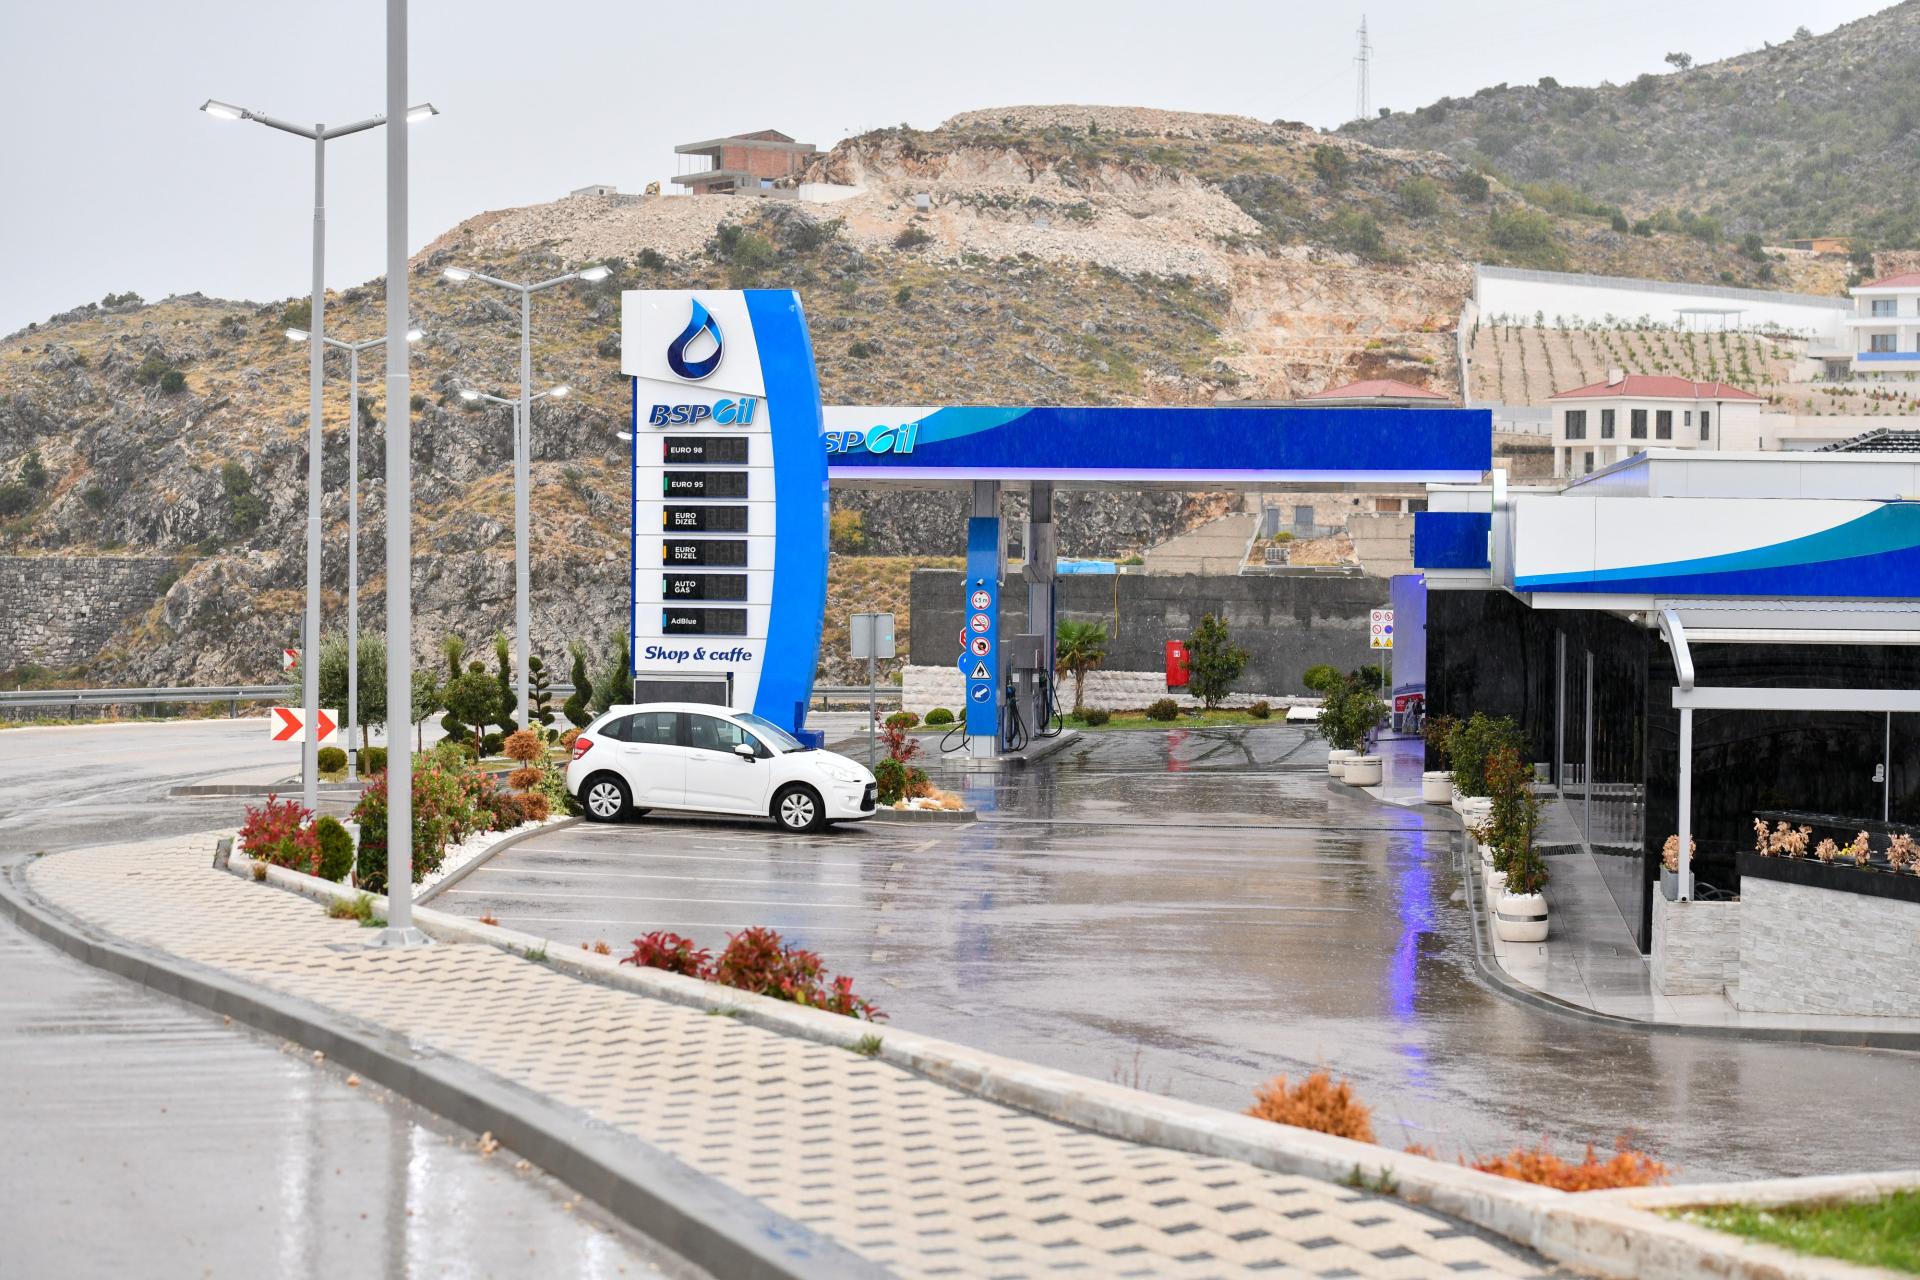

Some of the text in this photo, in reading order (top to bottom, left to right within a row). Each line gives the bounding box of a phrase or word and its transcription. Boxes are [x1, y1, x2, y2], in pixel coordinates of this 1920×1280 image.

[825, 423, 918, 453] SPOil
[645, 646, 752, 663] Shop & caffe
